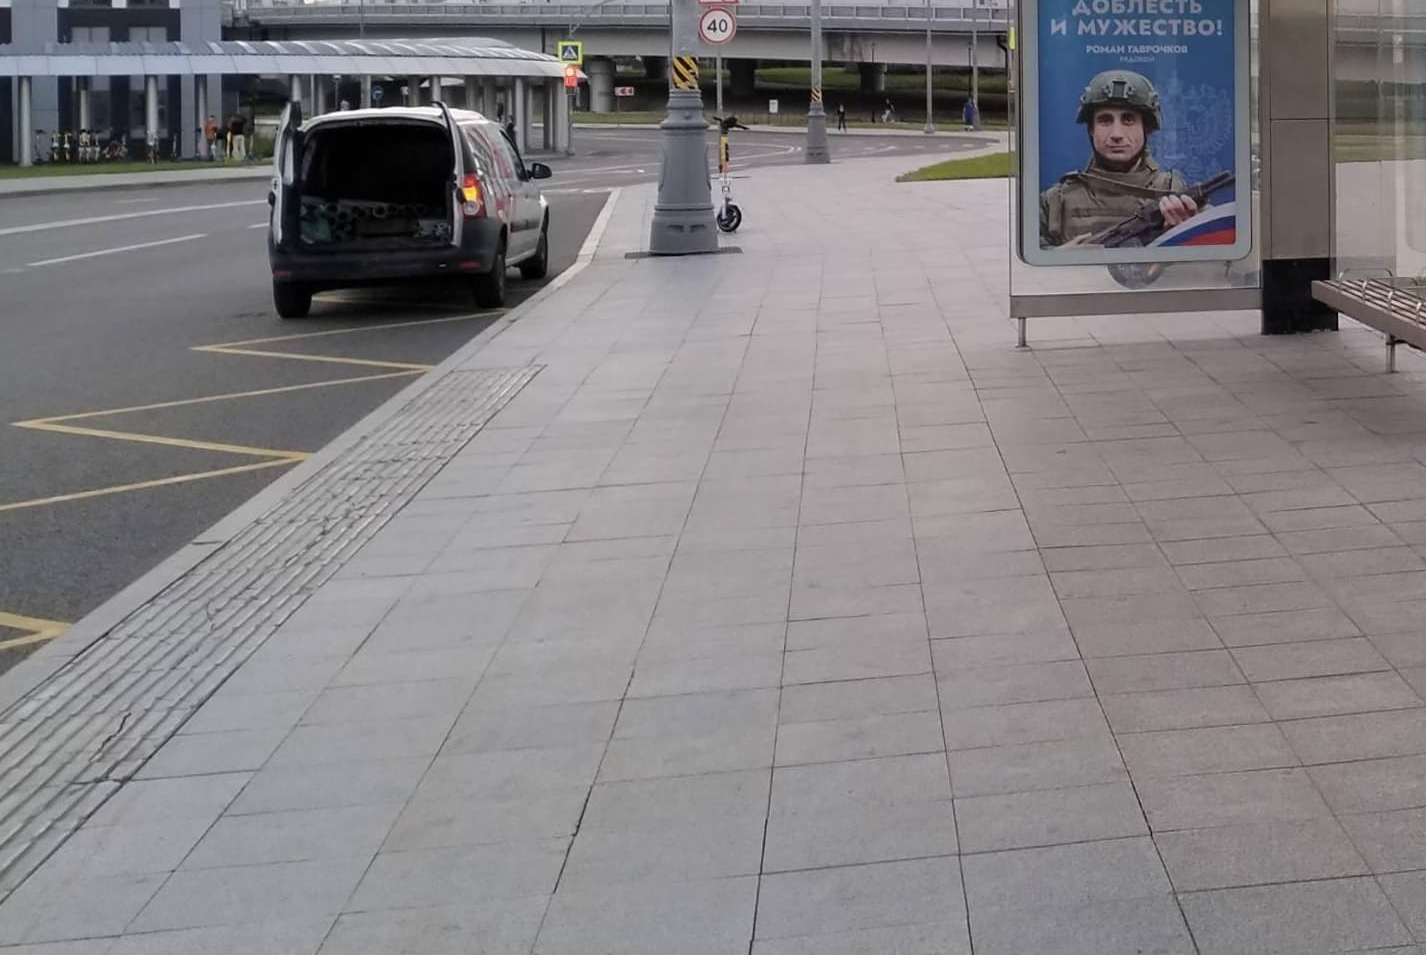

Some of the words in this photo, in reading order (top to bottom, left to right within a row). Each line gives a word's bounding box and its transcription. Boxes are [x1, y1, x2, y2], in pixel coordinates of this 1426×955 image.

[706, 18, 728, 33] 40
[1050, 18, 1067, 36] И
[1077, 18, 1223, 36] МУЖЕСТВО!
[1086, 44, 1125, 54] РОМАН
